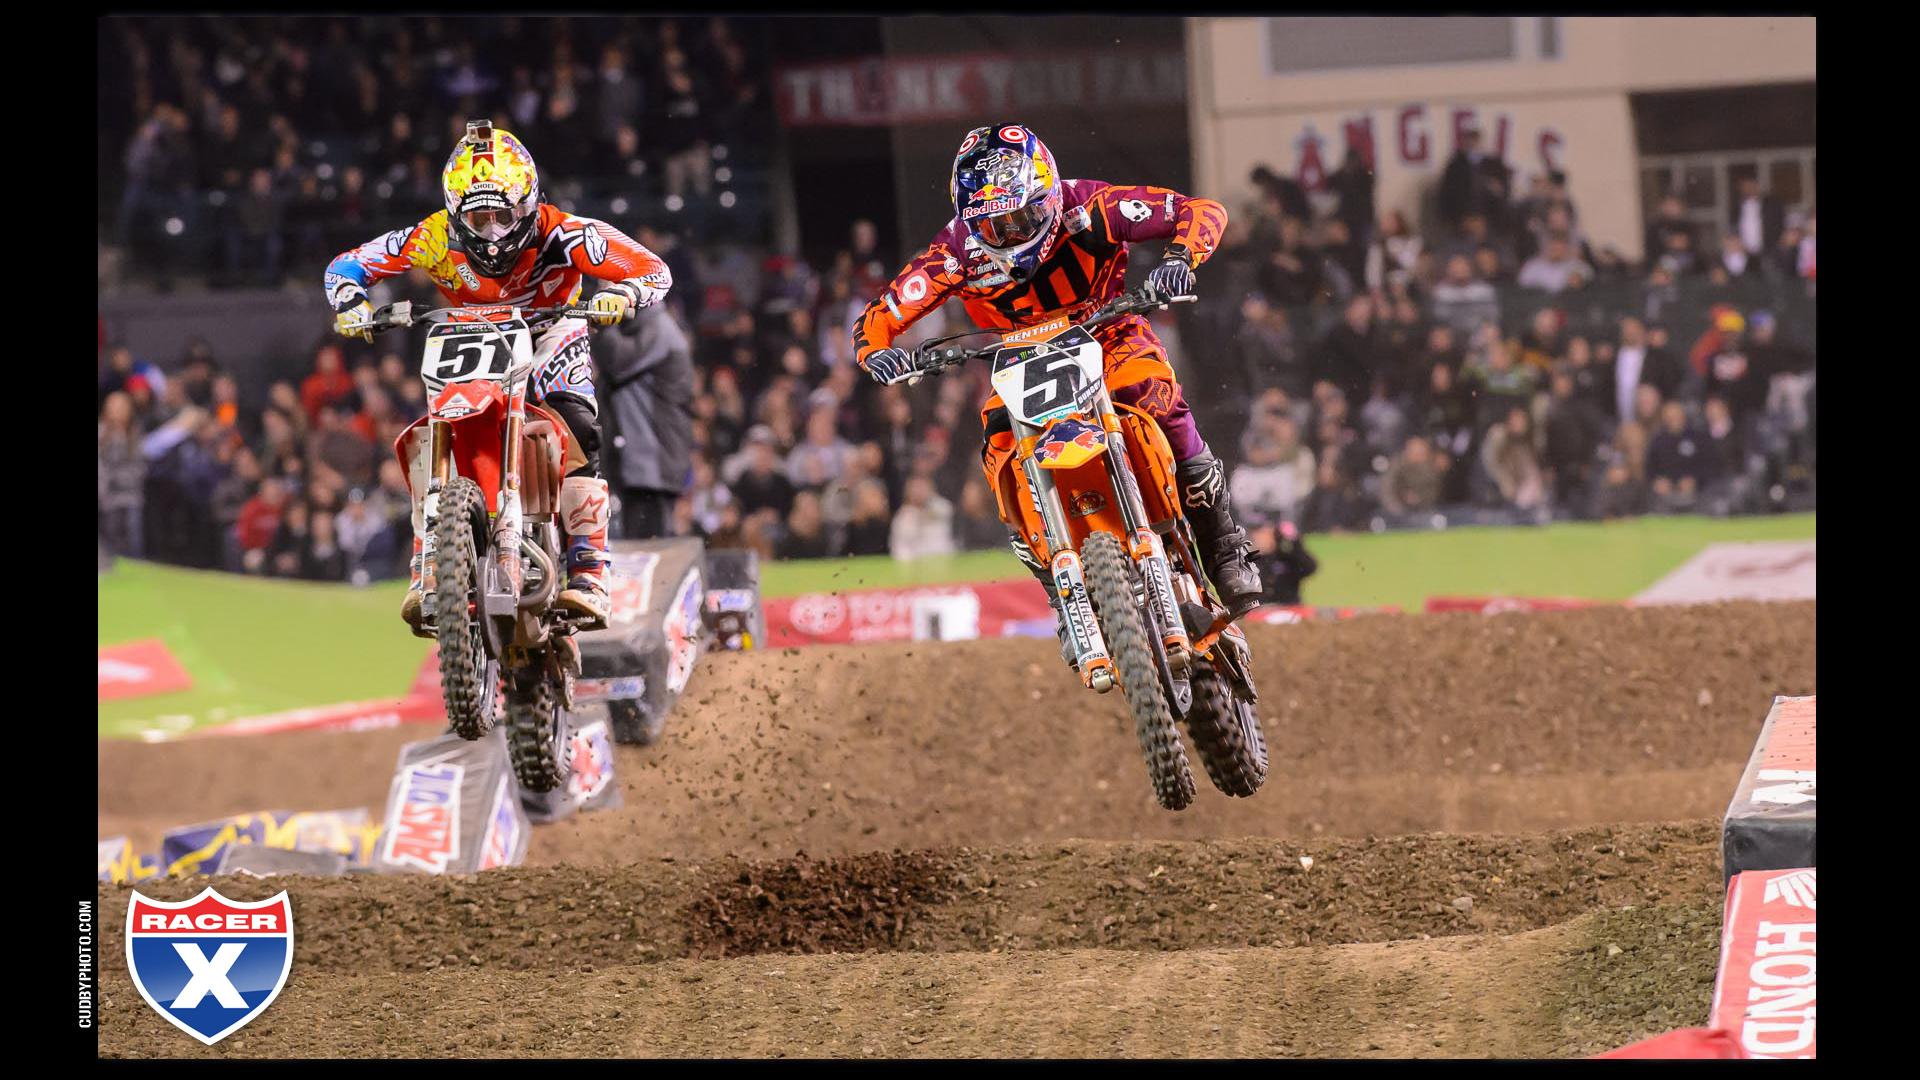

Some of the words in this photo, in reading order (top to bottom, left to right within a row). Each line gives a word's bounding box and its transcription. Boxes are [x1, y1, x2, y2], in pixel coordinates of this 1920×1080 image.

[465, 193, 504, 203] HONDA
[963, 203, 989, 219] Red
[990, 199, 1017, 212] Bull
[1005, 320, 1067, 342] RENTHAL
[437, 333, 517, 379] 51
[1023, 347, 1081, 419] 5
[1060, 576, 1091, 649] DNLOP
[1078, 589, 1098, 637] ATHENA
[1150, 560, 1176, 627] DUNLOP
[1740, 921, 1816, 1059] HOND
